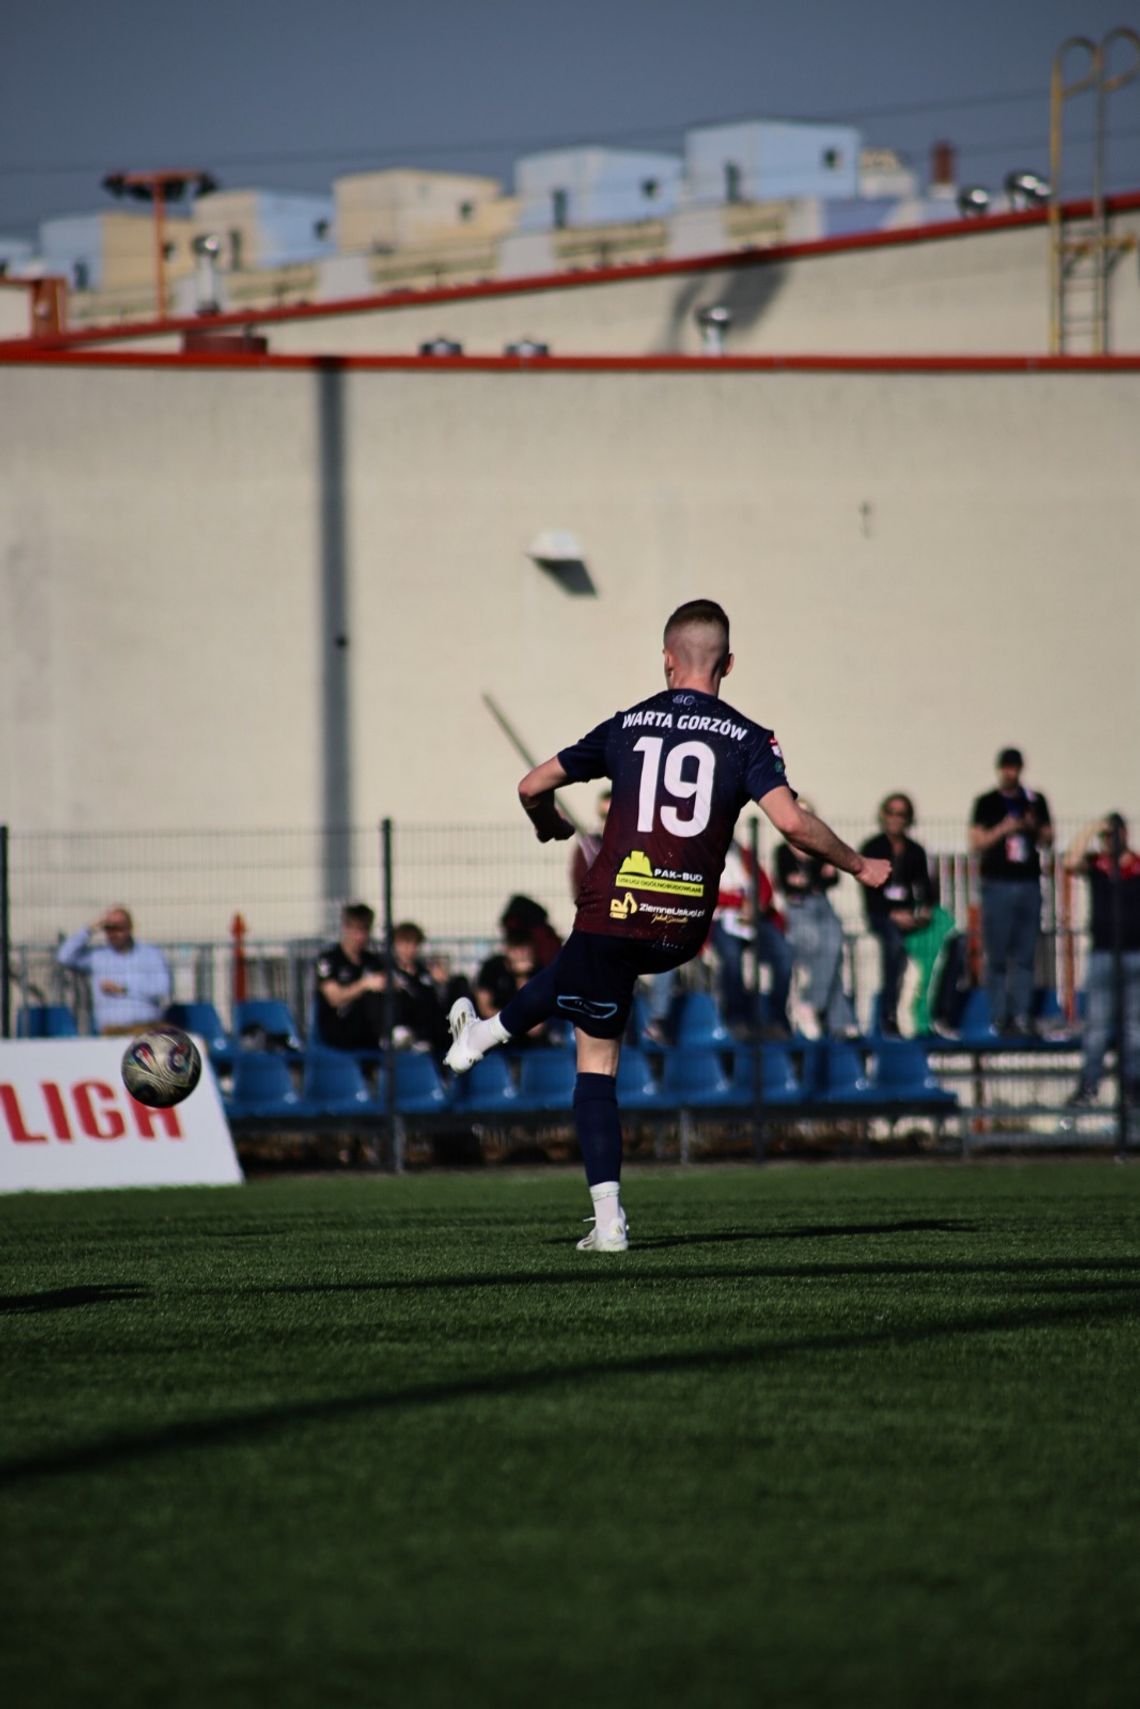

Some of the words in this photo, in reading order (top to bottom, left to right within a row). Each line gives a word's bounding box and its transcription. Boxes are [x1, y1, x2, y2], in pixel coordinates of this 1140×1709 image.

[621, 711, 673, 729] WARTA
[676, 714, 748, 741] GORZÓW
[632, 735, 716, 838] 19
[654, 868, 703, 882] PAK-BUD
